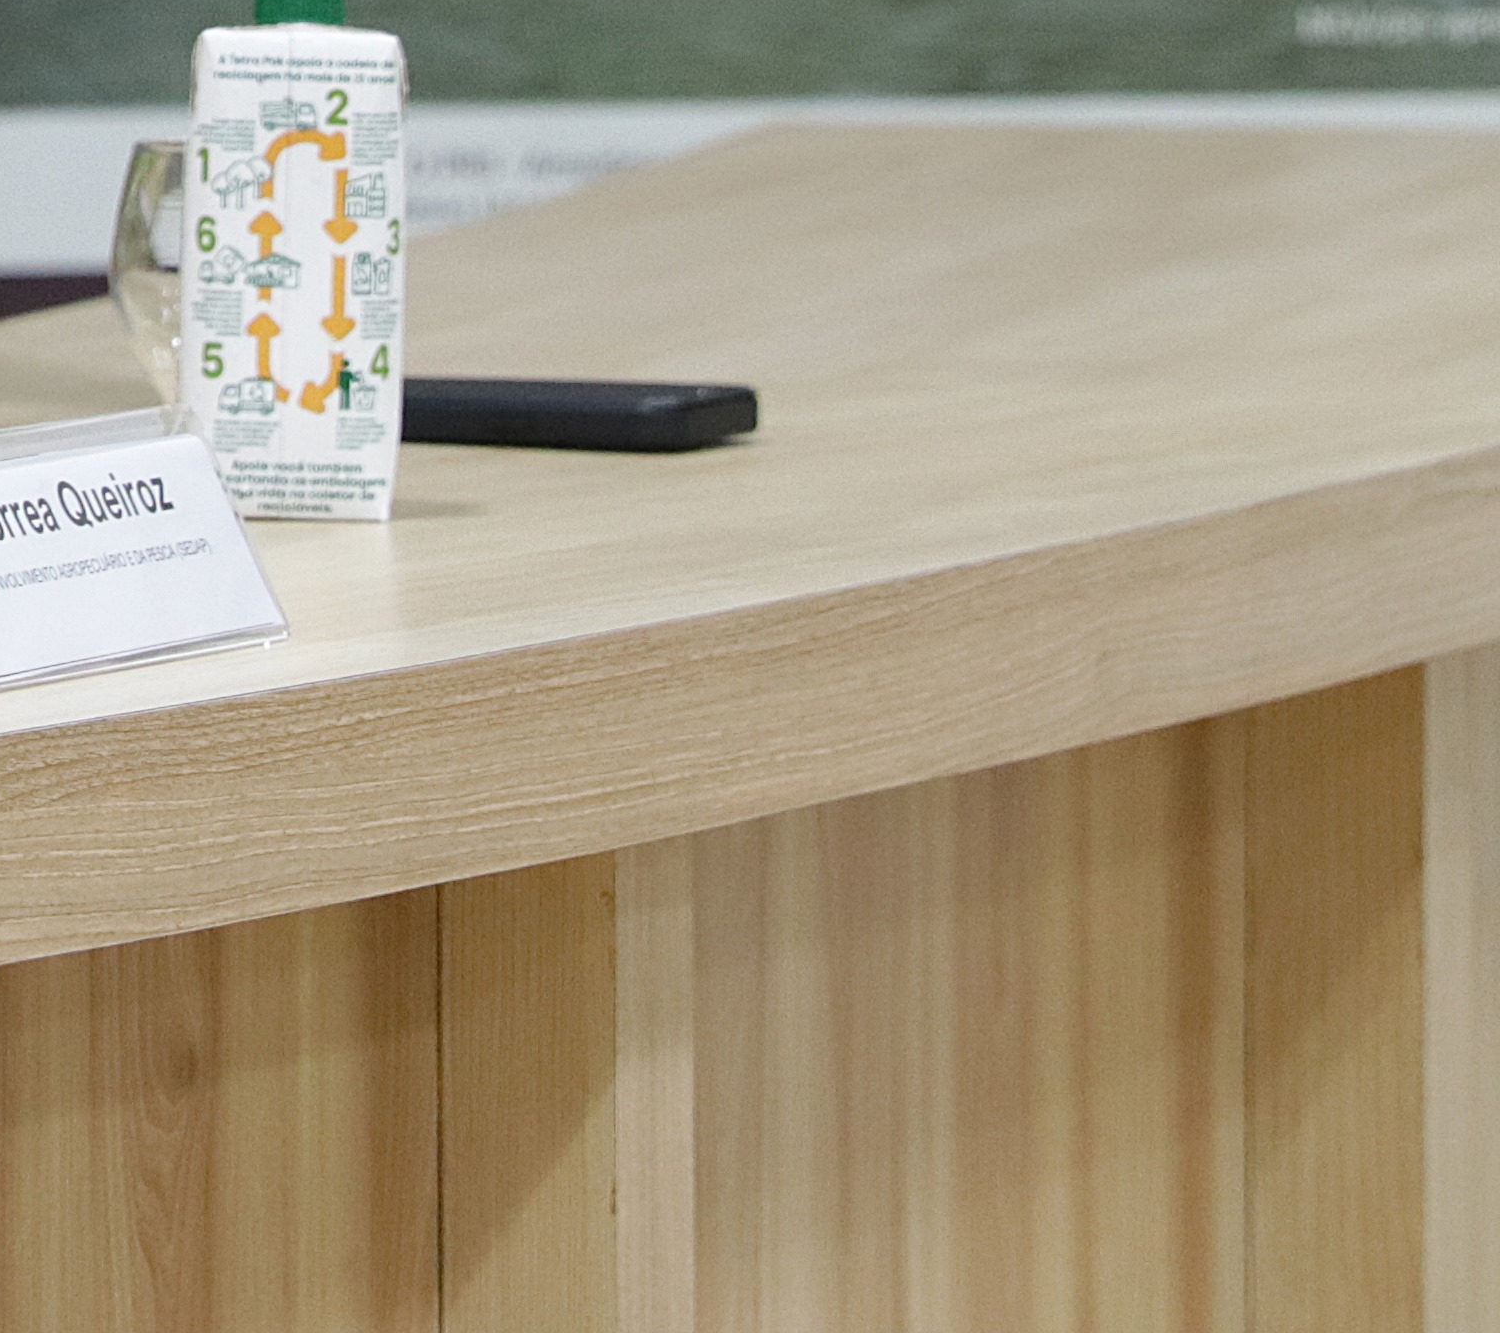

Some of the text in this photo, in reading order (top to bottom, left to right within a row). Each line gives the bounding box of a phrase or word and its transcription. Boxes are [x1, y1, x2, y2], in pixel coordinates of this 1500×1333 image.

[326, 89, 348, 125] 2
[198, 146, 209, 182] 1
[196, 216, 216, 253] 6
[386, 218, 401, 255] 3
[202, 342, 224, 378] 5
[370, 343, 390, 379] 4
[57, 472, 175, 528] Queiroz
